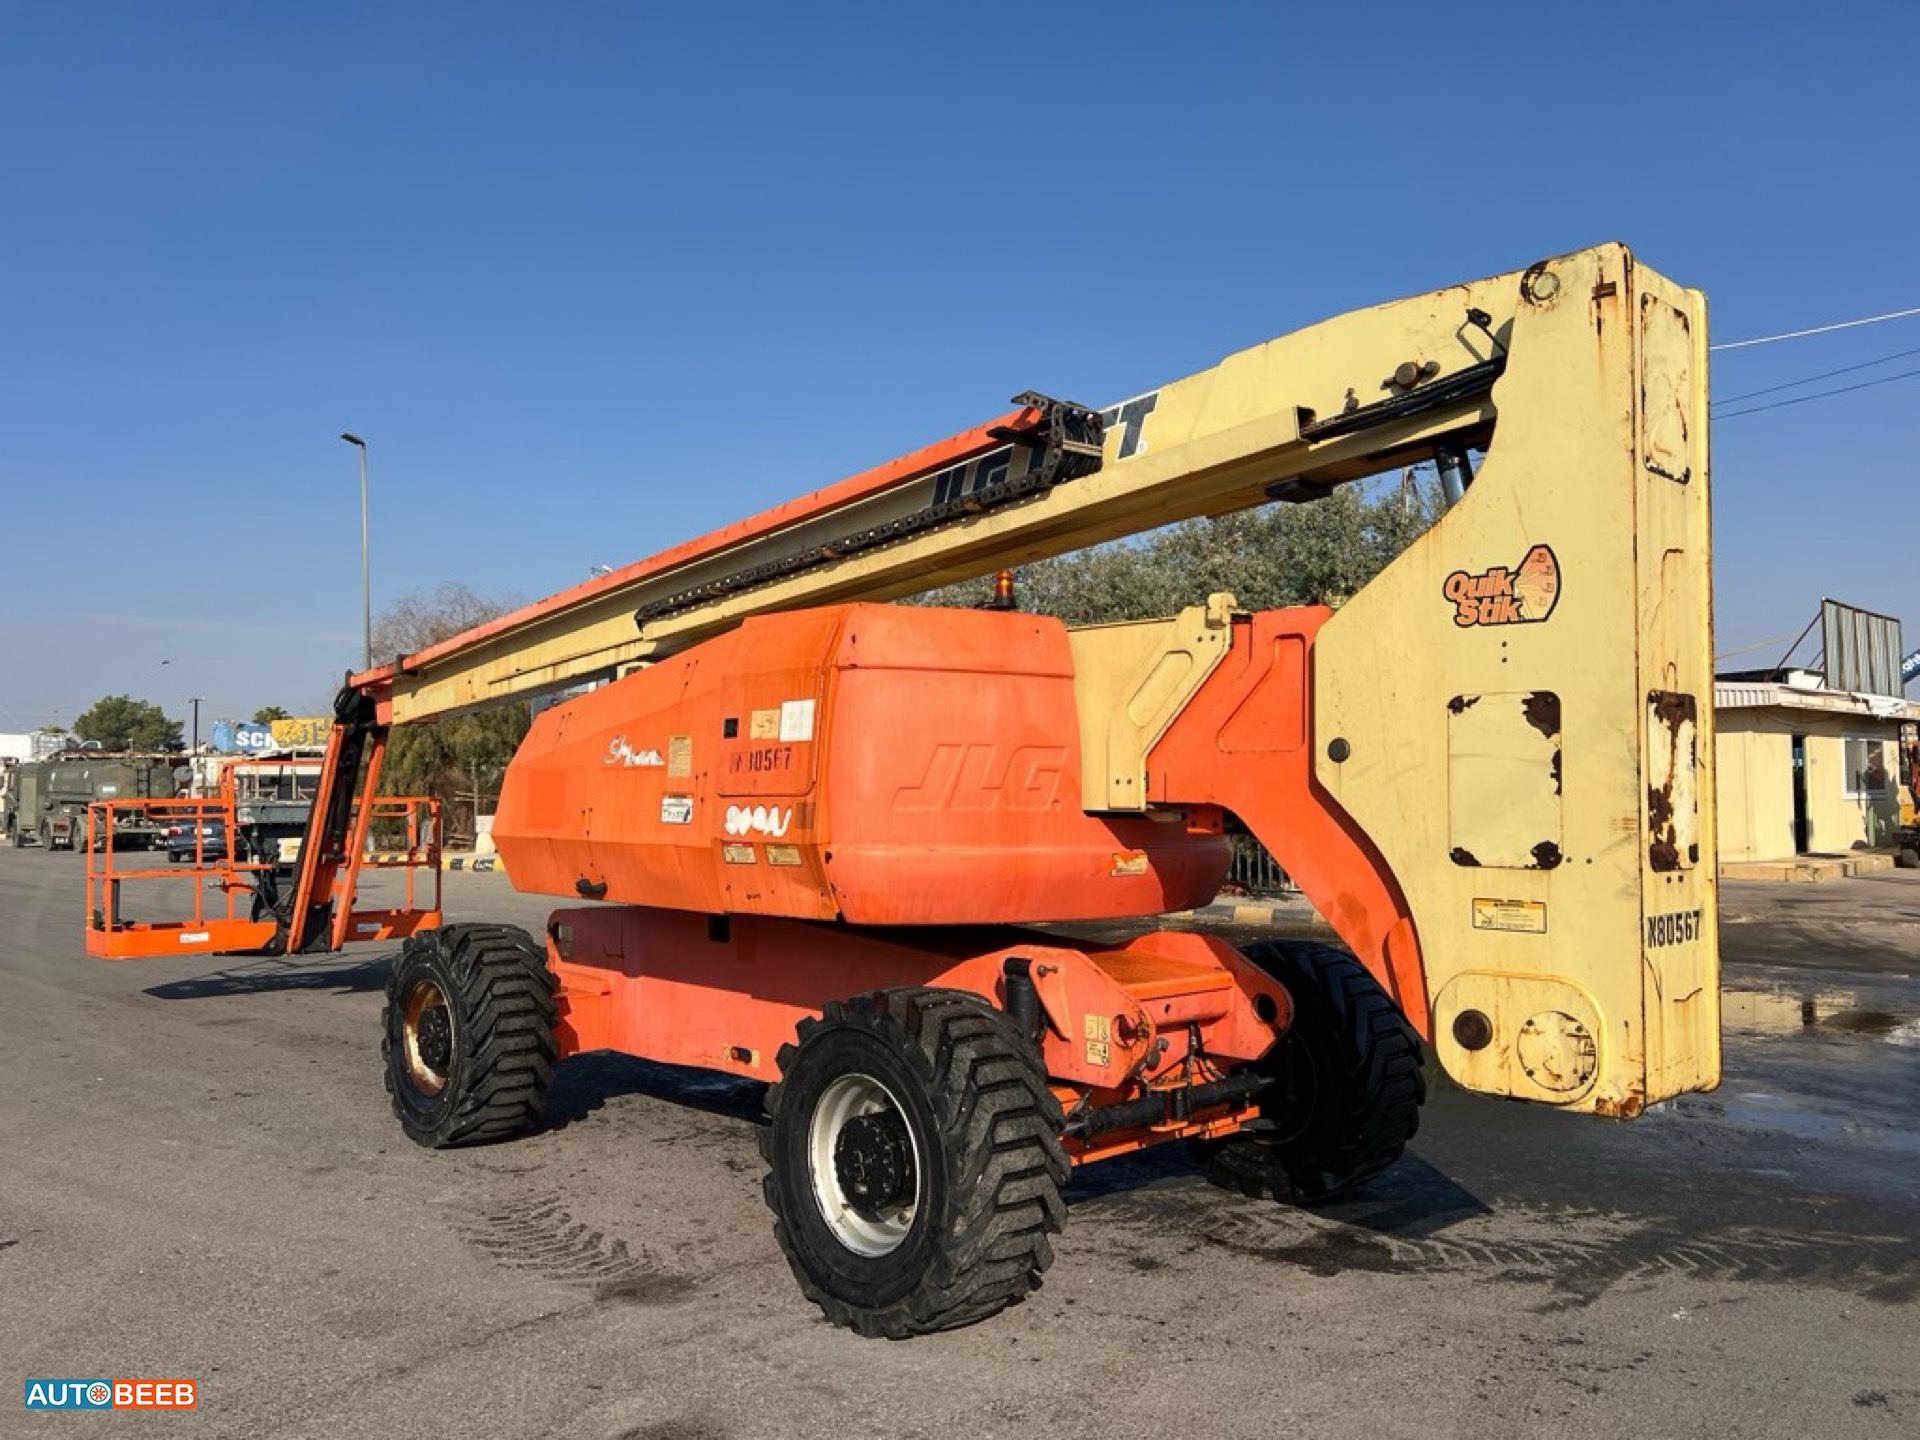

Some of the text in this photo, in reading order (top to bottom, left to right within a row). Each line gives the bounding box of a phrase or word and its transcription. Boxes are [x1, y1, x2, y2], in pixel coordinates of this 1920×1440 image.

[1443, 567, 1516, 601] Quik
[1455, 595, 1522, 626] Stik
[893, 744, 1069, 811] JLG
